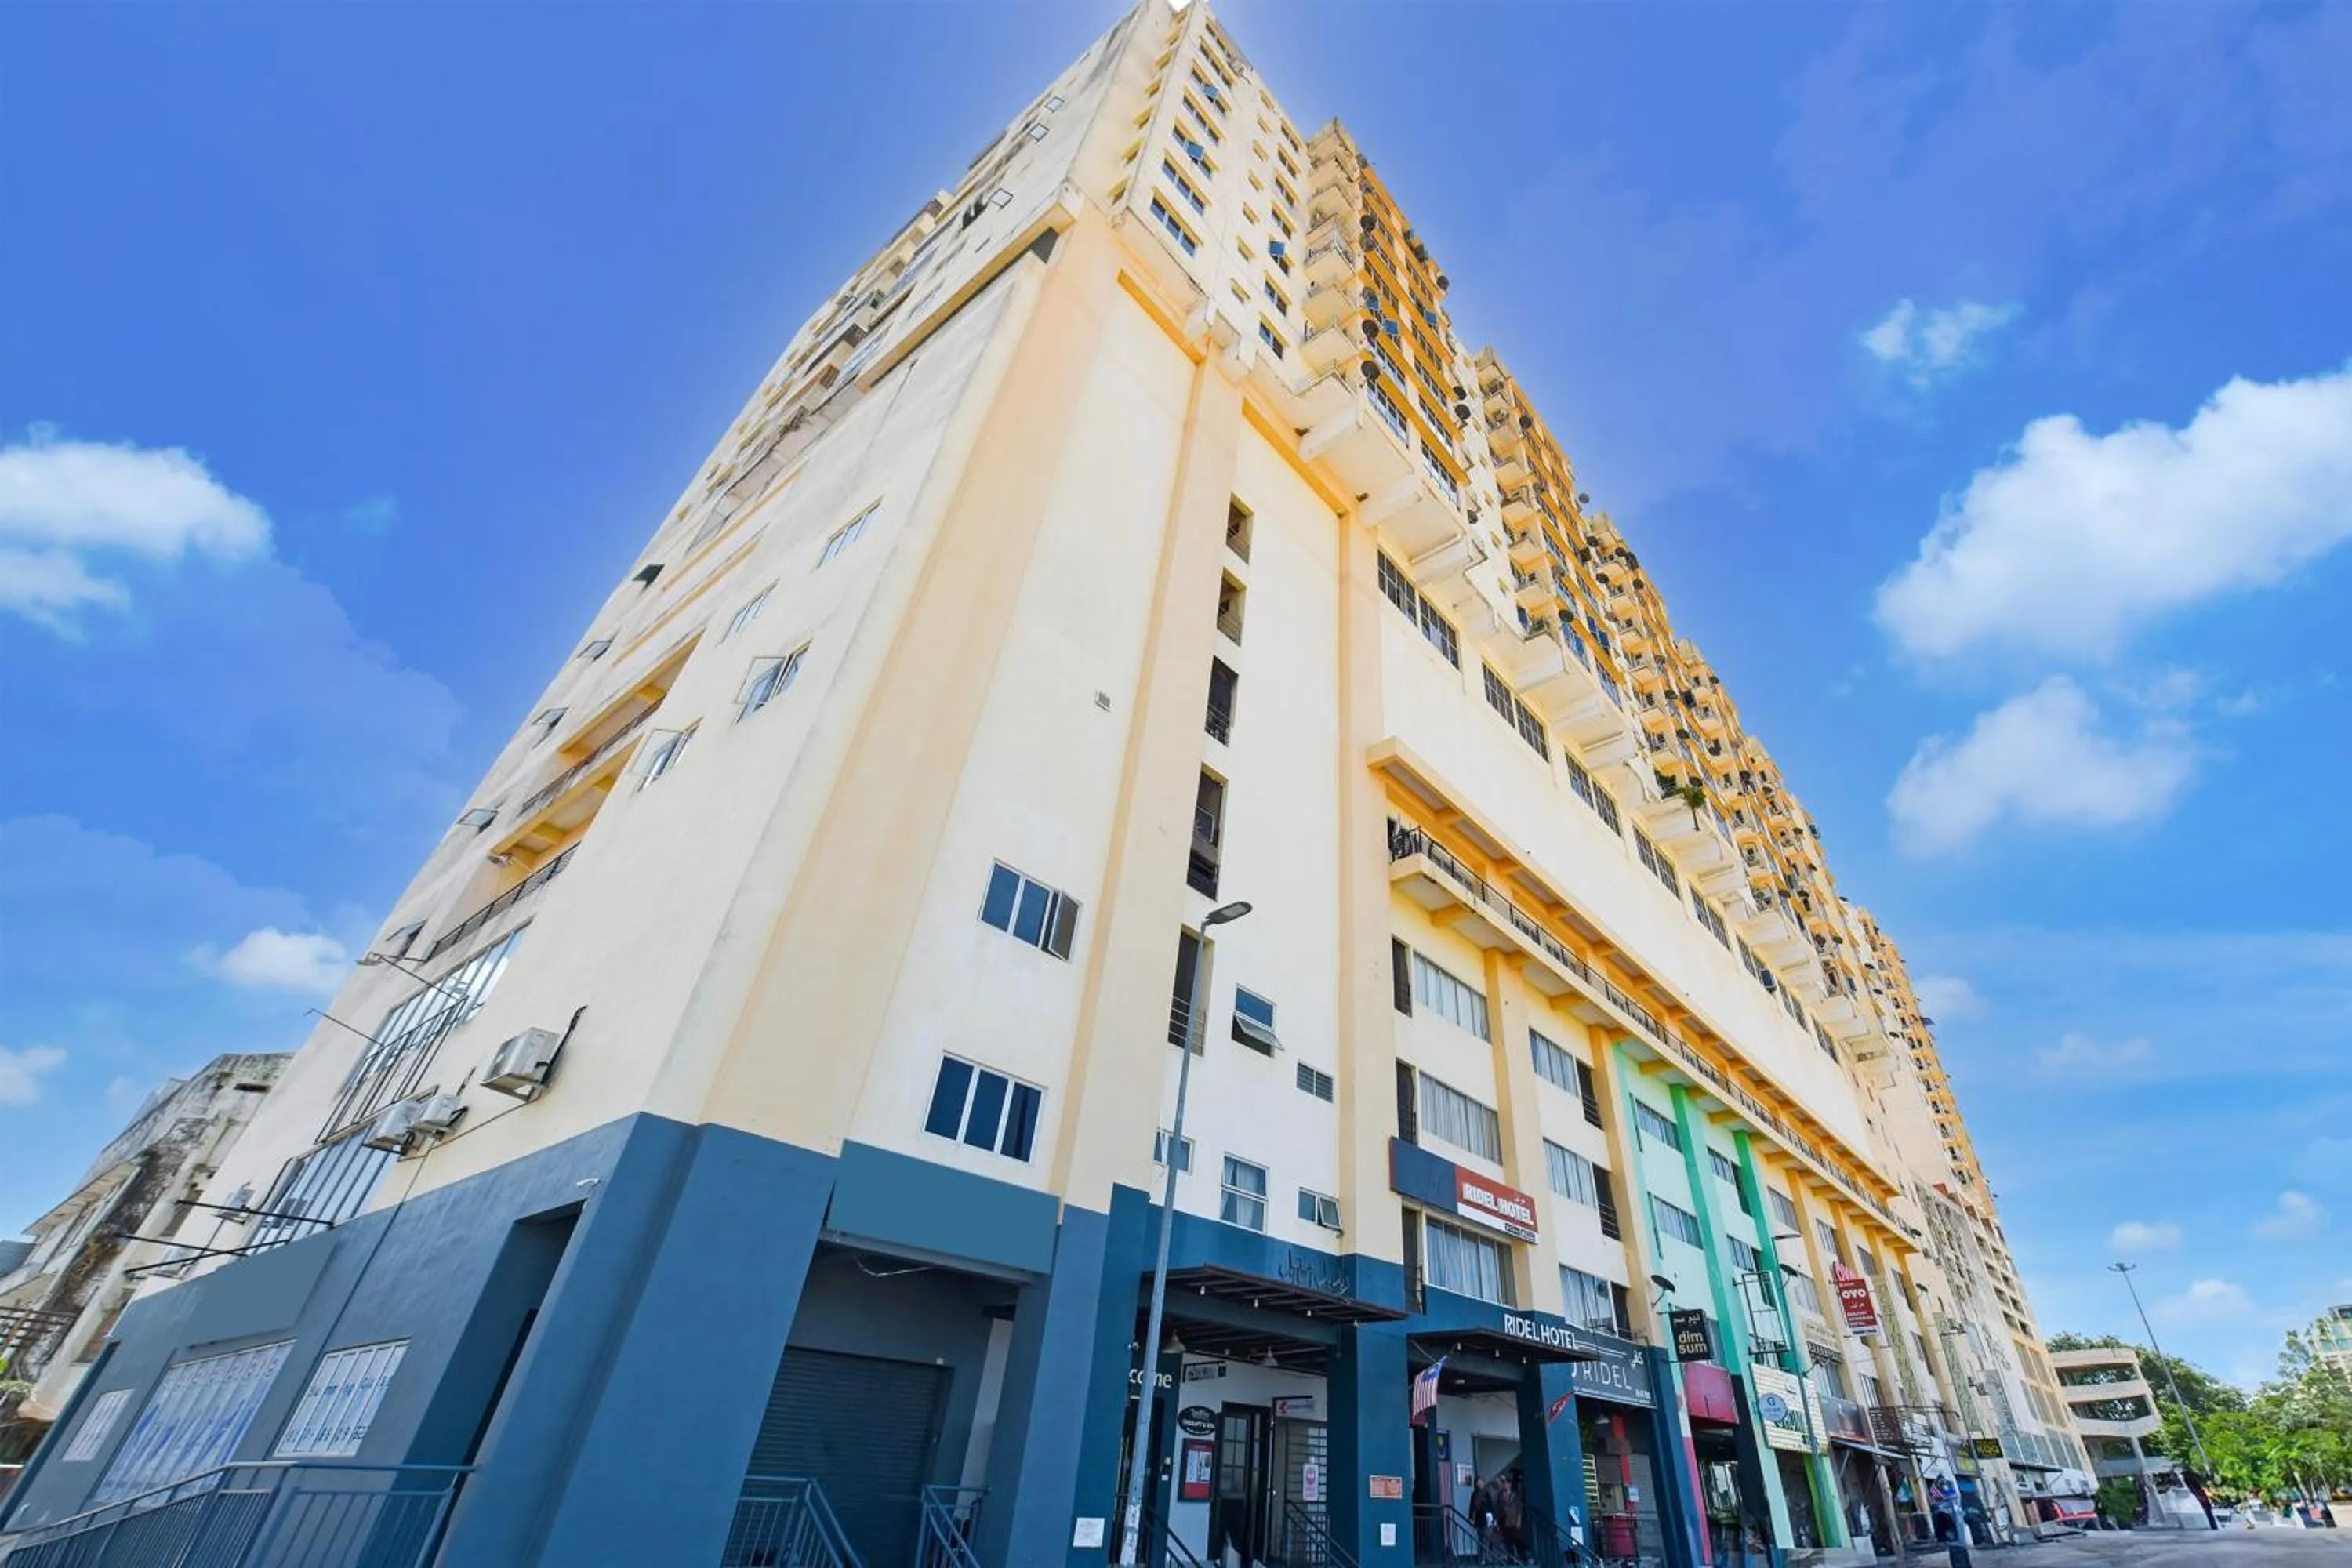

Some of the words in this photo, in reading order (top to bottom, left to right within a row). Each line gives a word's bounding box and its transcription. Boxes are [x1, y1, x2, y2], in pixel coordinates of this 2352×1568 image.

[1462, 1181, 1498, 1211] RIDEL
[1497, 1196, 1534, 1225] HOTEL
[1842, 1287, 1867, 1300] OYO
[1504, 1313, 1540, 1341] RIDEL
[1541, 1321, 1580, 1350] HOTEL
[1679, 1330, 1704, 1344] dim
[1679, 1342, 1708, 1355] sum
